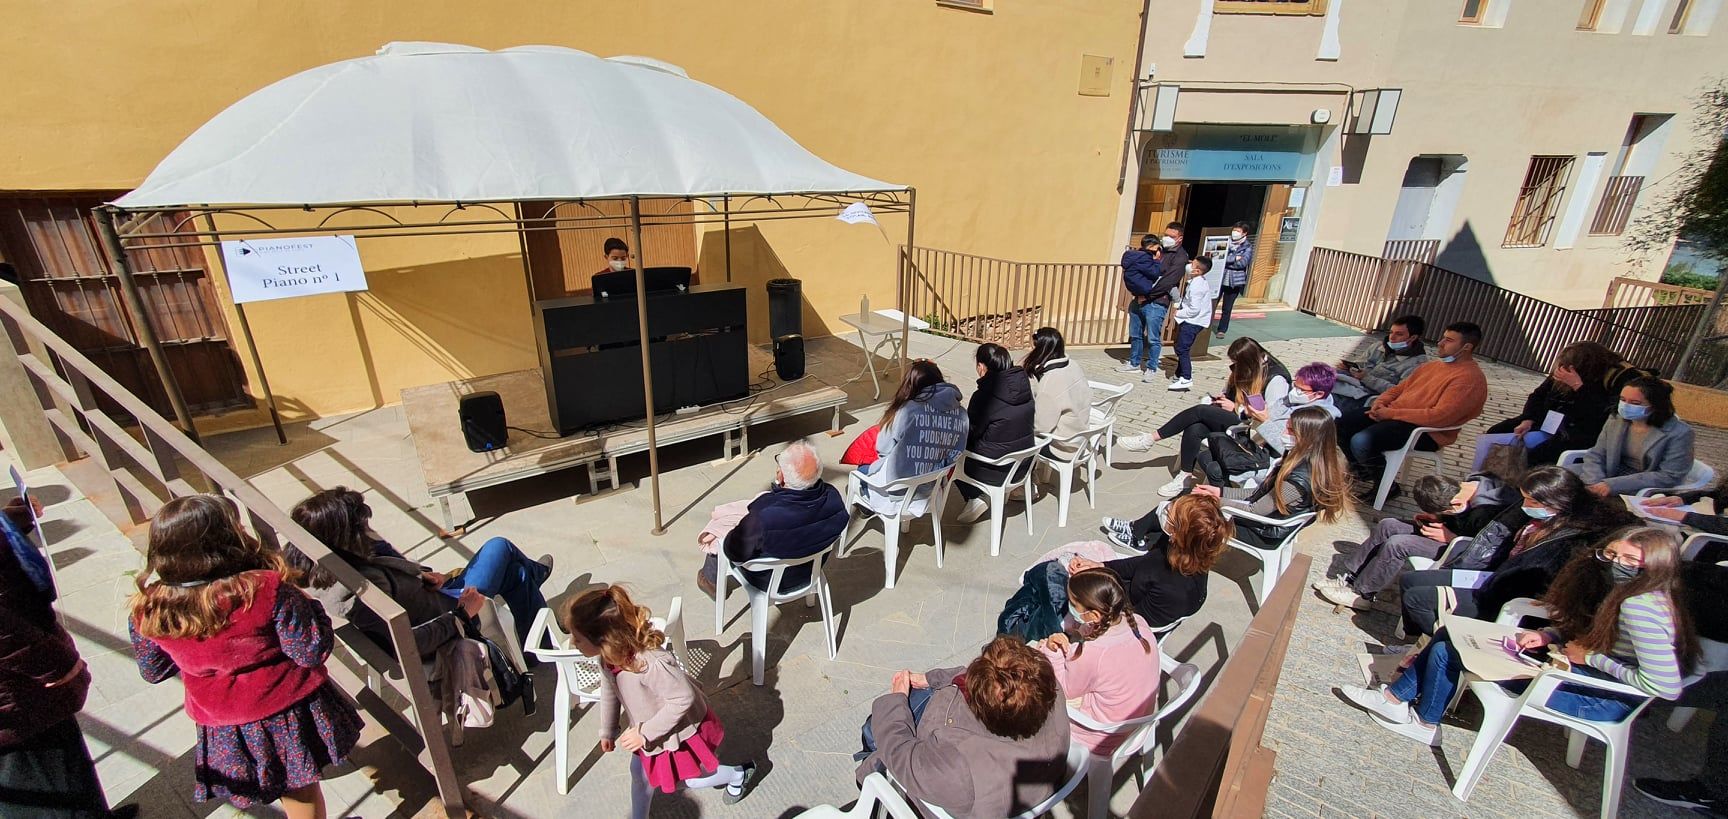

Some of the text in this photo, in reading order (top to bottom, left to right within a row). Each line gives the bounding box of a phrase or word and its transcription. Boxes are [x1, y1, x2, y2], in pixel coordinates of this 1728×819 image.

[1147, 149, 1190, 159] TURISME
[1244, 153, 1264, 161] SALA
[1224, 162, 1281, 171] D'EXPOSICIONS
[278, 264, 321, 276] Street
[262, 277, 308, 289] Piano
[335, 272, 340, 282] 1
[914, 414, 930, 427] YOU
[932, 416, 952, 430] HAVE
[919, 429, 960, 446] PUDDING IF
[906, 445, 922, 458] YOU
[924, 446, 945, 461] DON'T
